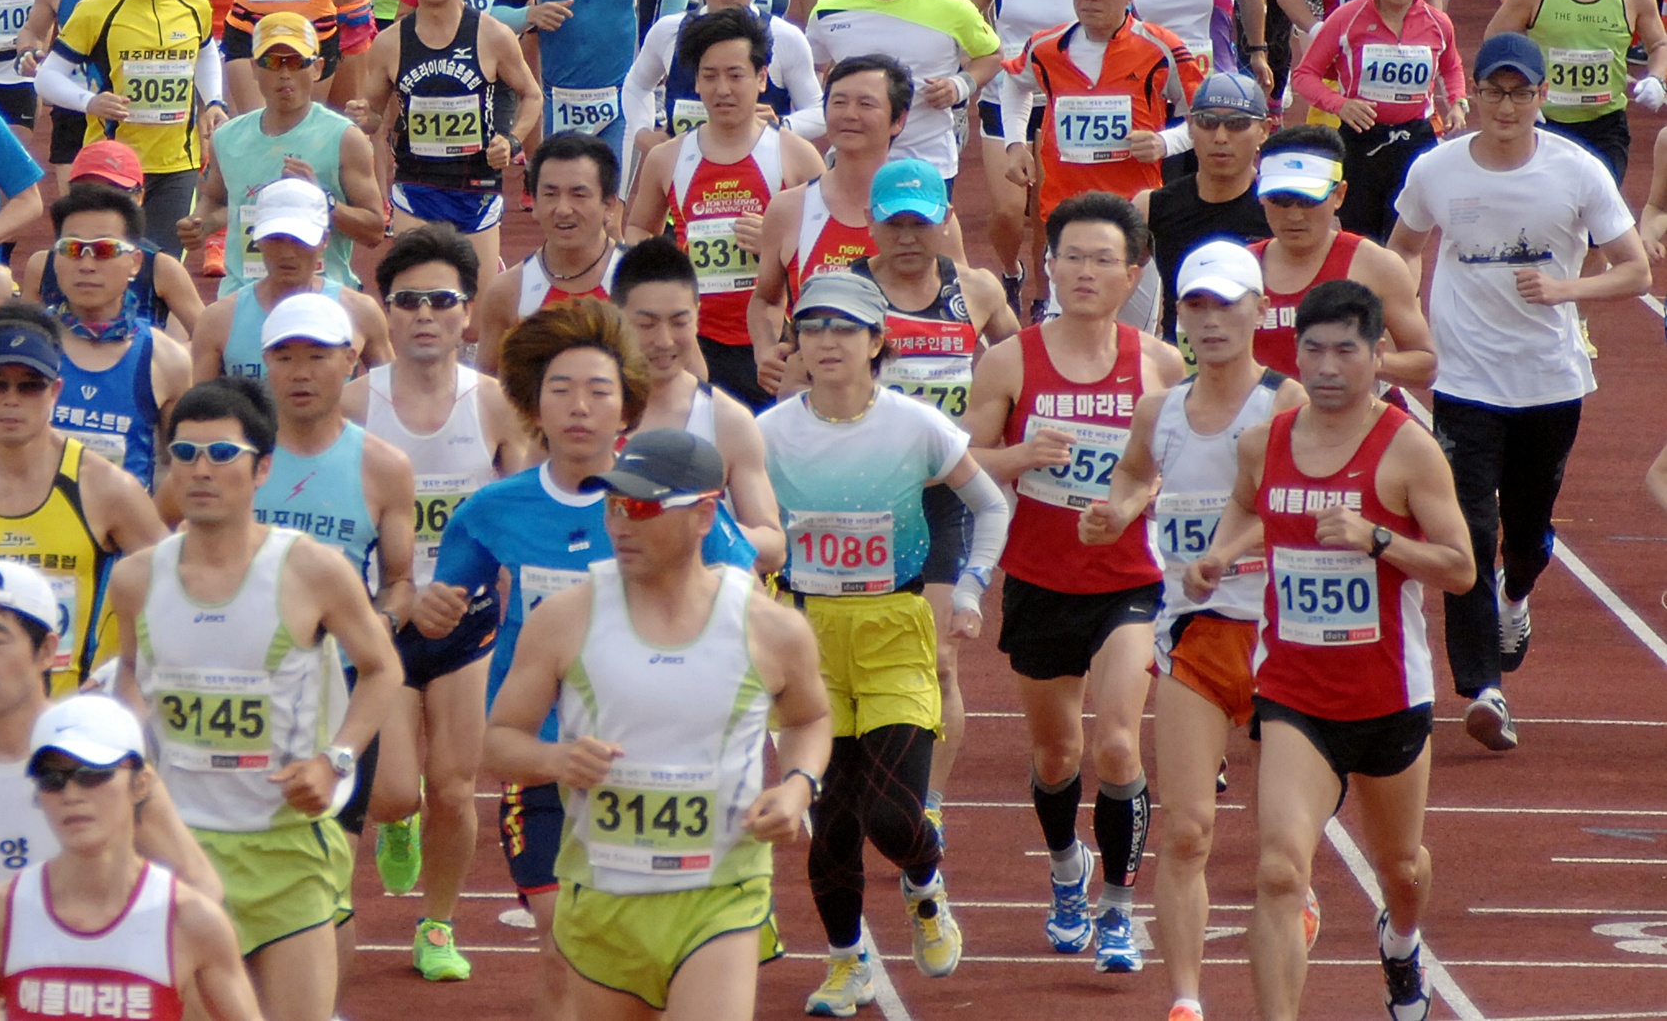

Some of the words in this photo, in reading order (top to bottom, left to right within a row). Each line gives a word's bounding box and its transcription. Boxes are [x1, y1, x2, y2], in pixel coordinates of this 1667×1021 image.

[1554, 11, 1572, 21] THE
[1576, 13, 1608, 24] SHILLA
[1367, 60, 1428, 85] 1660
[1551, 63, 1610, 87] 3193
[127, 77, 189, 103] 3052
[412, 111, 478, 137] 3122
[557, 100, 615, 126] 1589
[1060, 113, 1128, 142] 1755
[702, 188, 752, 201] balance
[714, 179, 739, 190] new
[704, 206, 741, 215] RUNNING
[742, 203, 763, 213] CLUB
[705, 198, 732, 207] TOKYO
[692, 238, 760, 270] 331
[838, 243, 866, 256] new
[1034, 392, 1134, 419] 애플마라톤
[1034, 445, 1121, 488] 552
[1067, 494, 1091, 507] duty
[796, 531, 888, 569] 1086
[842, 580, 865, 592] duty
[1279, 573, 1372, 615] 1550
[1324, 628, 1348, 641] duty
[1350, 627, 1375, 639] free
[161, 694, 265, 739] 3145
[596, 789, 710, 838] 3143
[17, 978, 152, 1019] 애플마라톤
